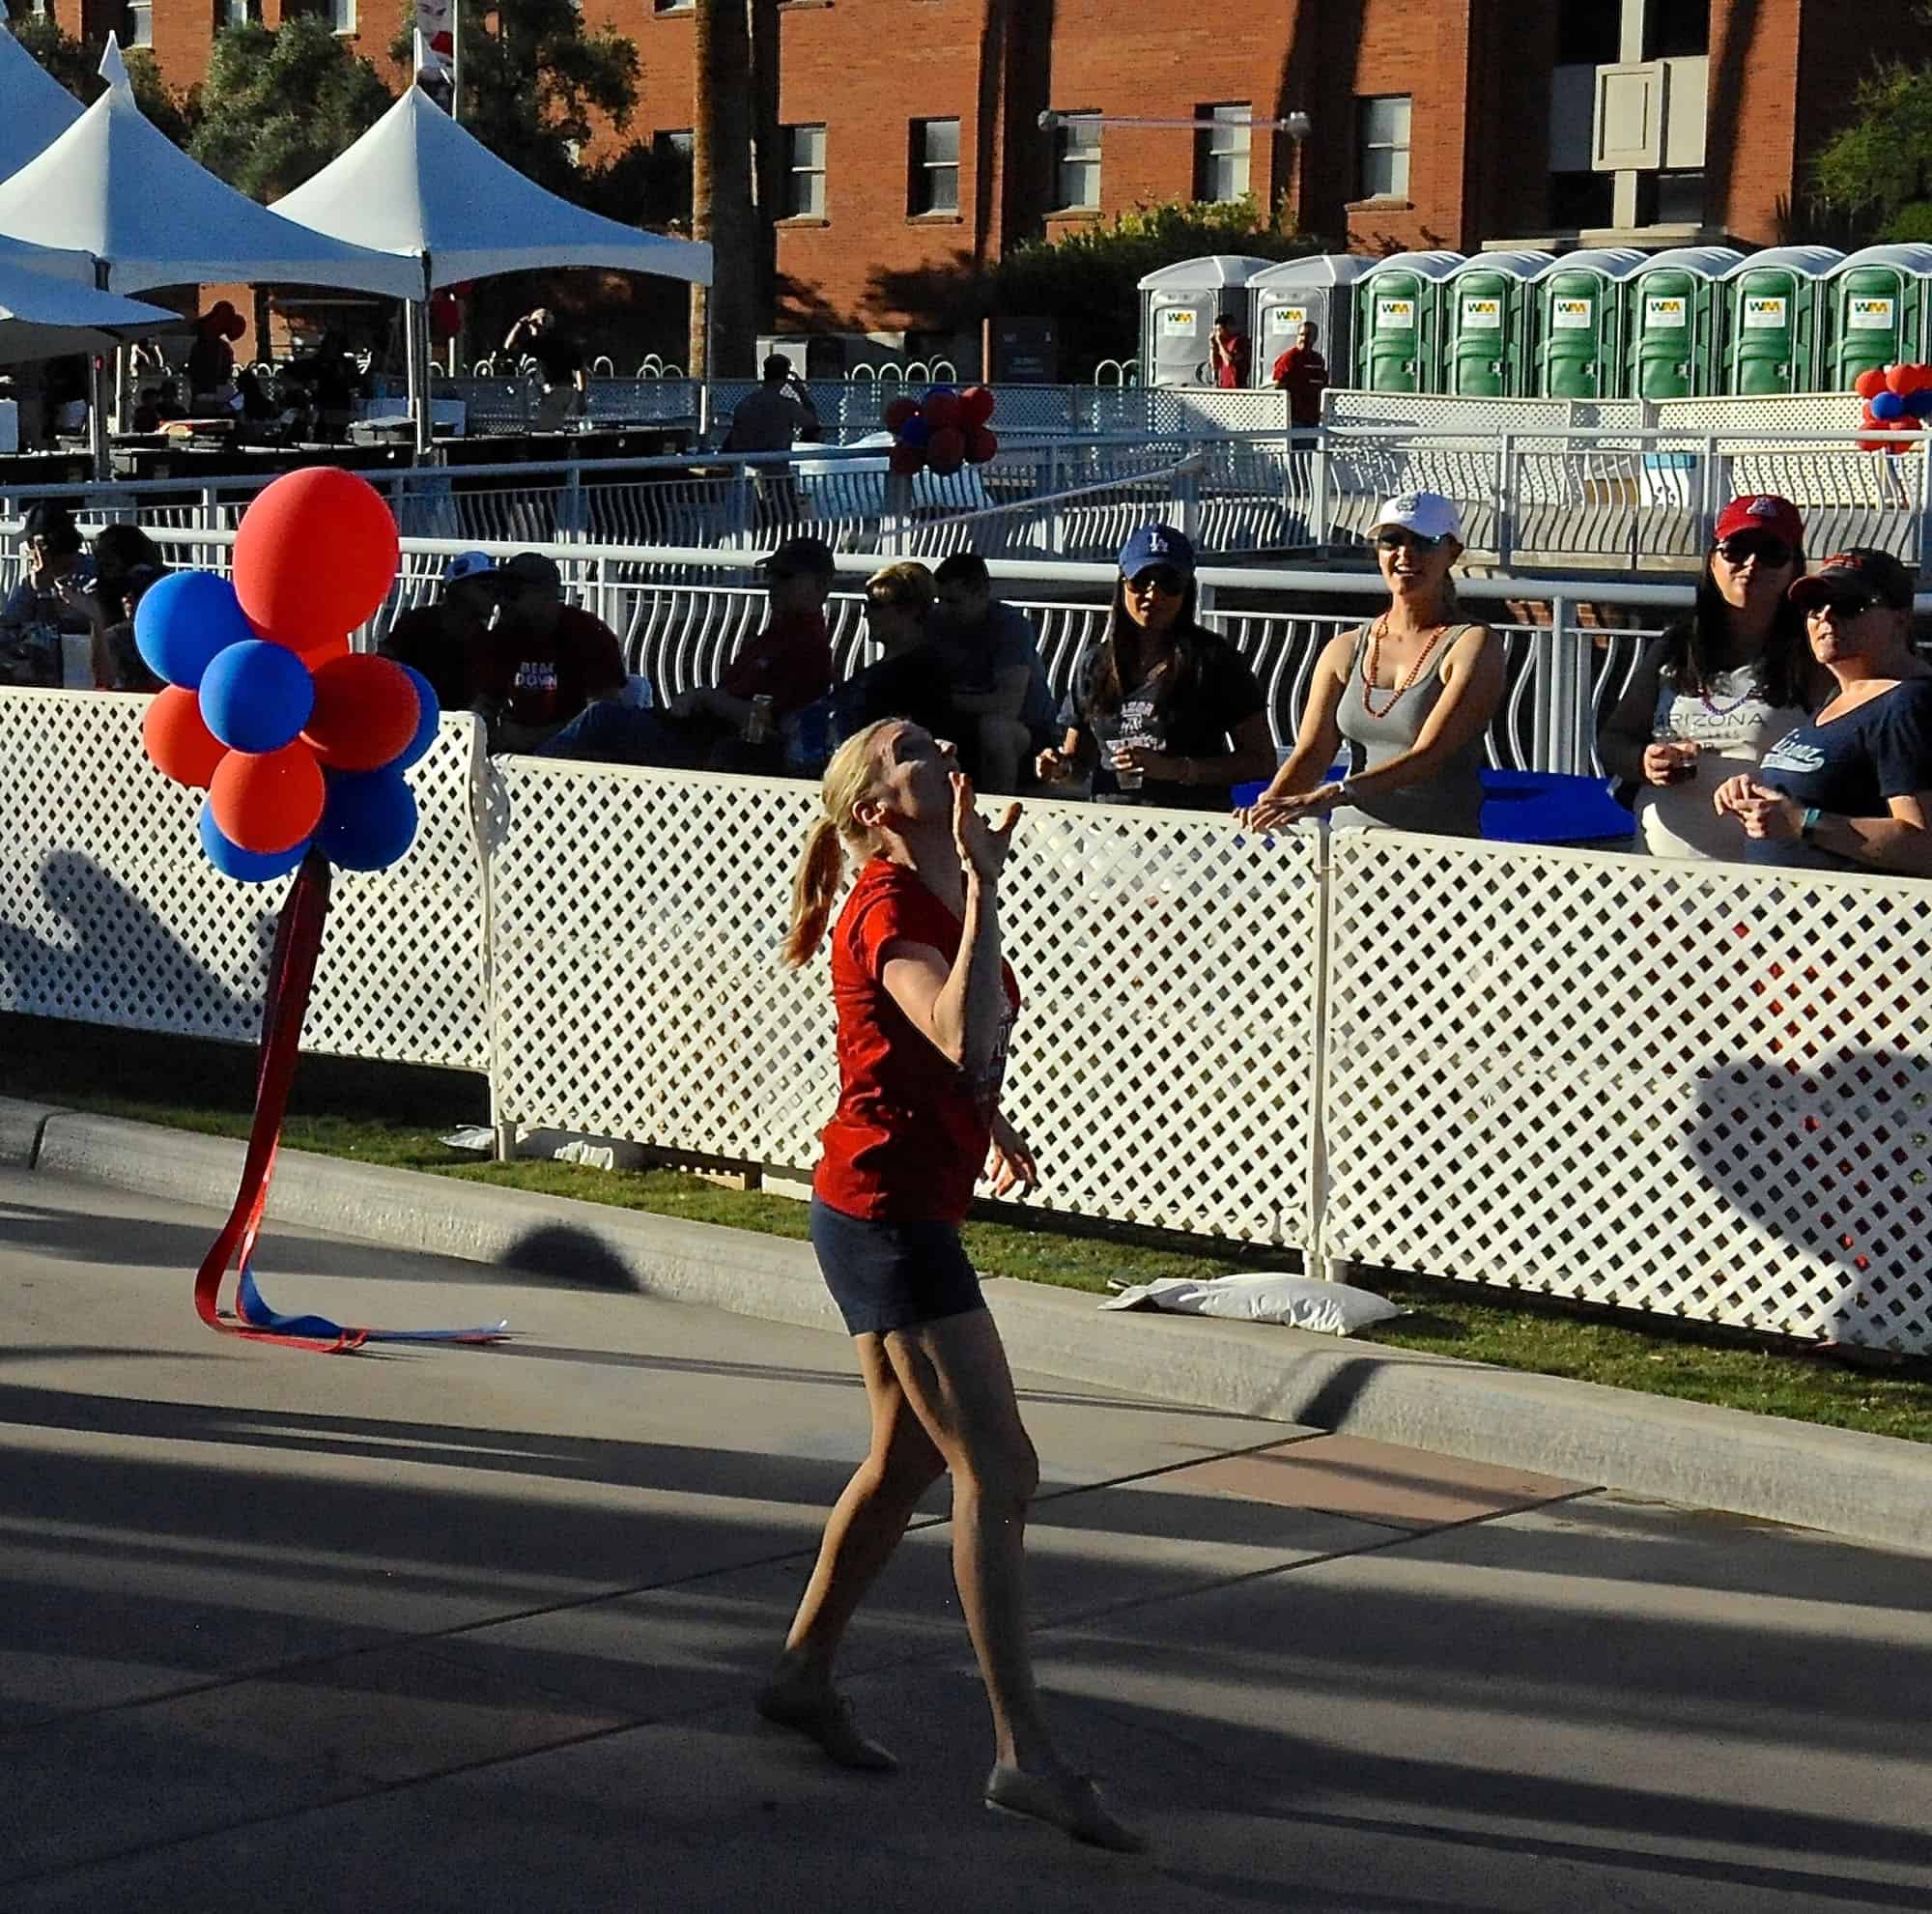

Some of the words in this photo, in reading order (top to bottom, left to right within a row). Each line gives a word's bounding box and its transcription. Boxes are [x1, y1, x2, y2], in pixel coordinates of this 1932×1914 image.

[1382, 302, 1409, 313] WM
[1467, 302, 1496, 313] WM
[1557, 301, 1587, 314] WM
[1650, 300, 1681, 312] WM
[1749, 300, 1780, 312] WM
[1854, 301, 1887, 314] WM
[1168, 311, 1191, 324] WM
[1276, 310, 1302, 322] WM
